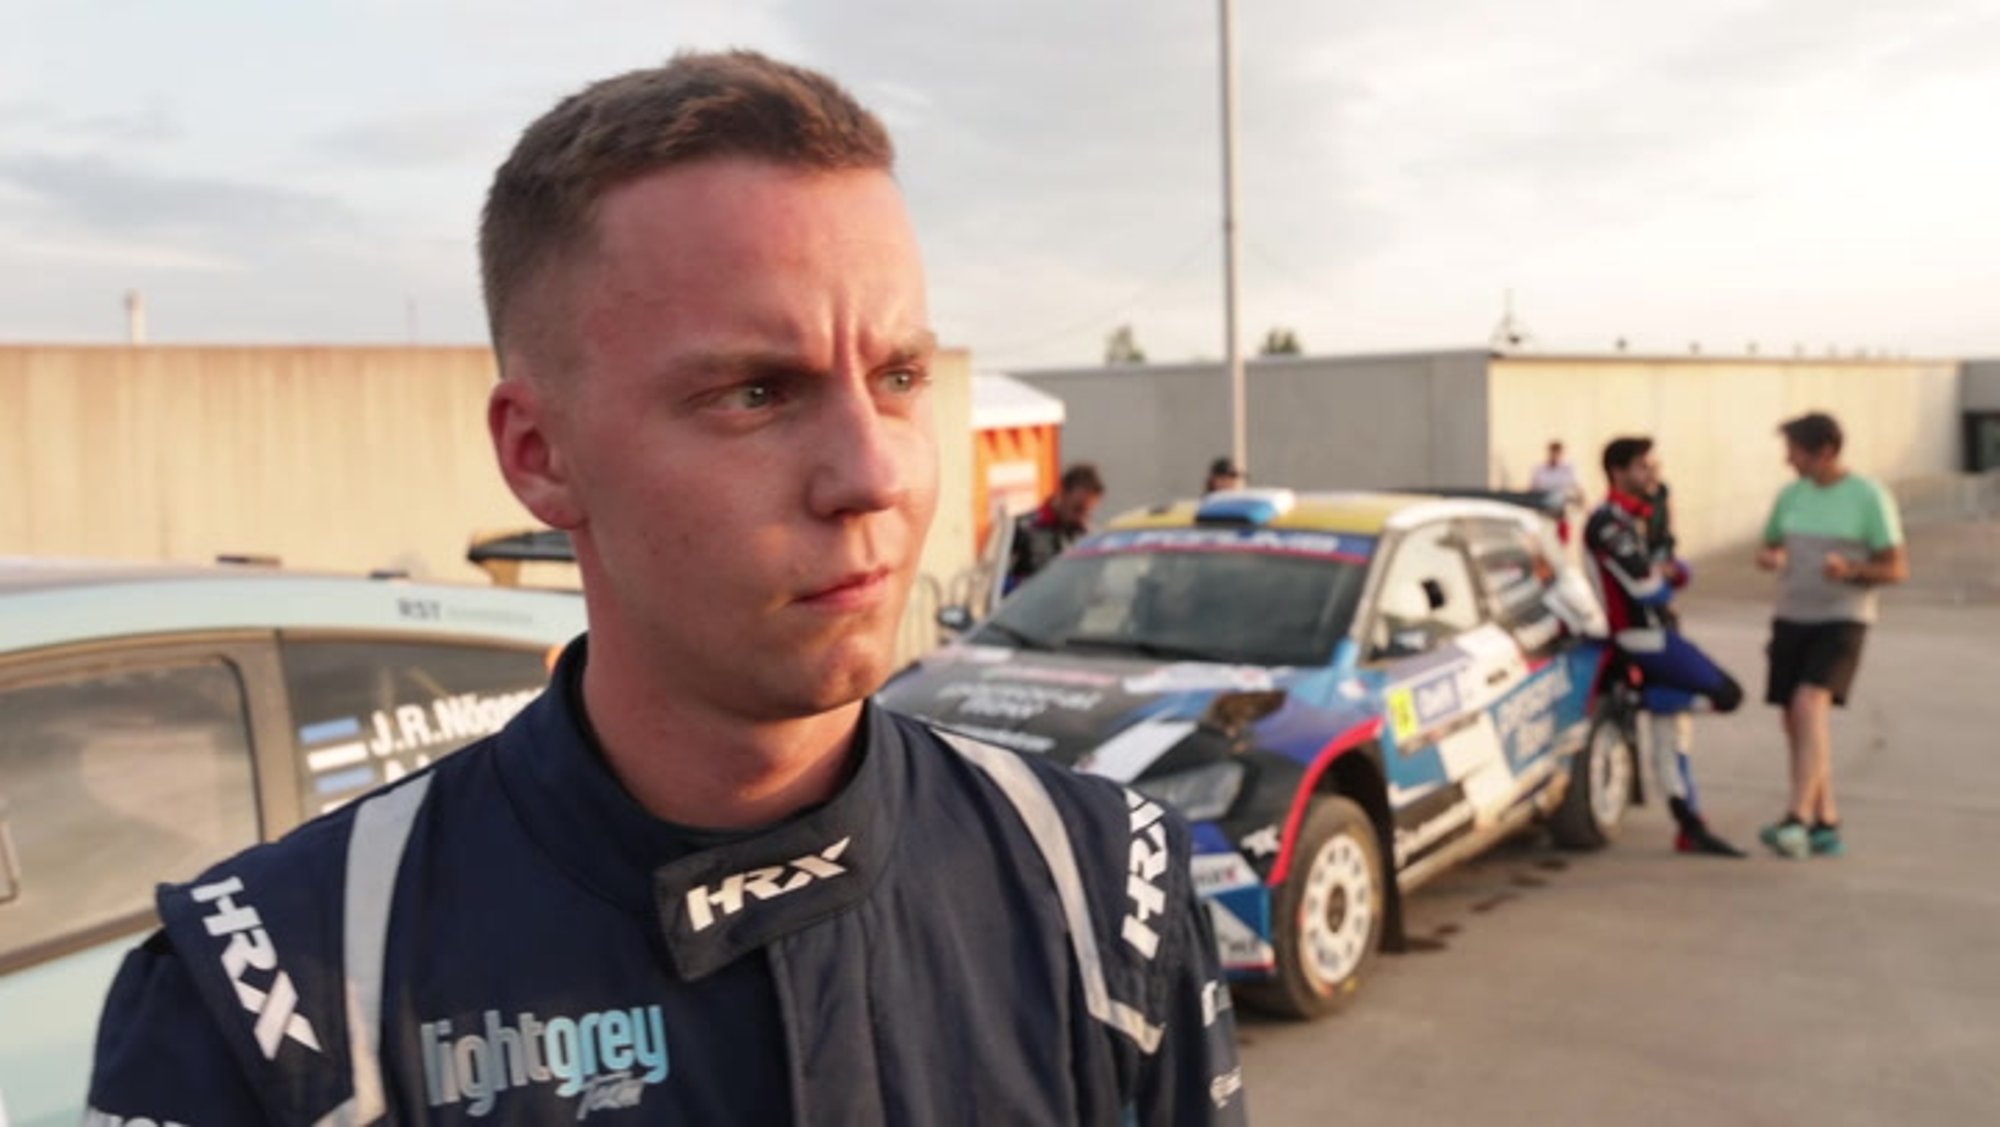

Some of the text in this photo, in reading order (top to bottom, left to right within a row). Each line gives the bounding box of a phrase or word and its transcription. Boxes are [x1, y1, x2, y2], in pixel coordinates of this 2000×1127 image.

[686, 836, 850, 932] HRX
[190, 876, 322, 1061] HRX
[420, 1004, 669, 1117] lightgrey
